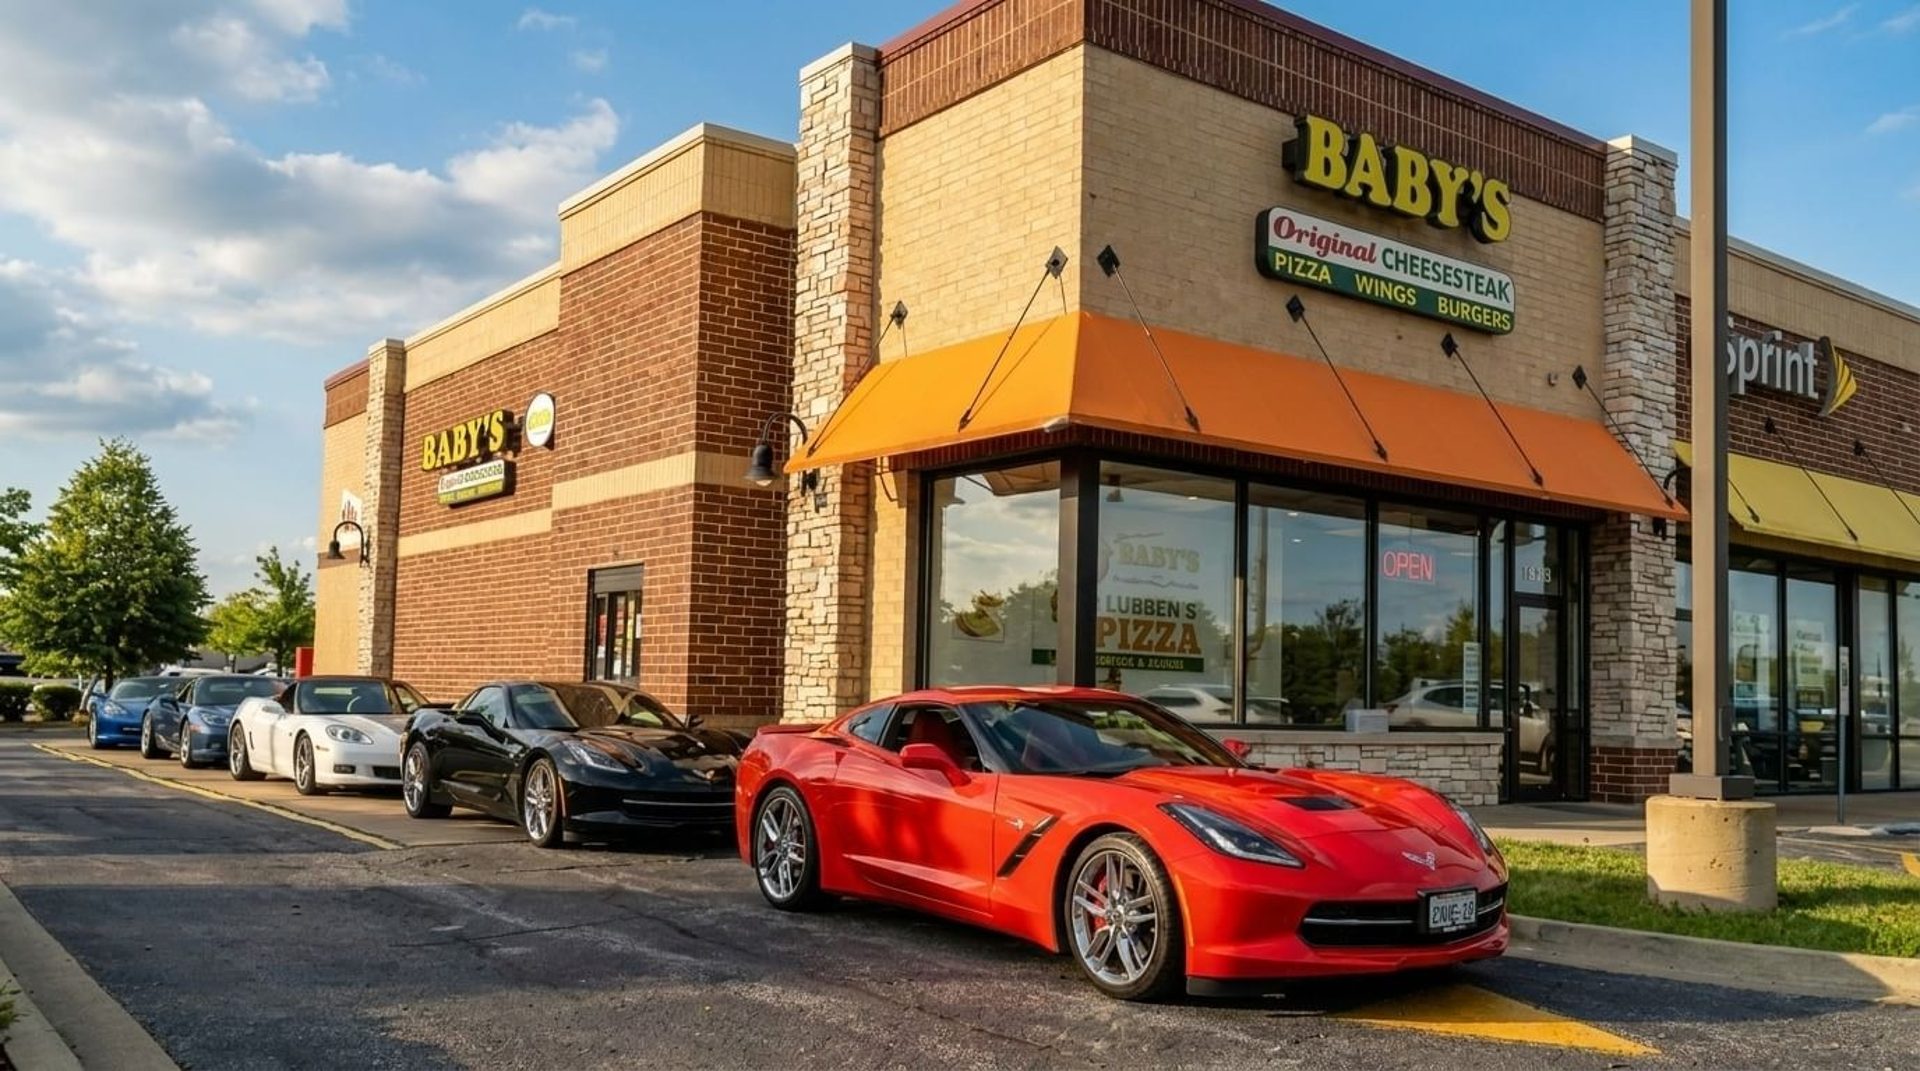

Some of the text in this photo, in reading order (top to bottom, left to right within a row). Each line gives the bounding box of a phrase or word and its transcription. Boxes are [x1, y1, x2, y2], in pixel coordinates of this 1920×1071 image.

[1303, 114, 1512, 242] BABY'S
[1273, 216, 1511, 303] Original CHEESESTEAK
[1274, 252, 1511, 331] PIZZA WINGS BURGERS
[422, 409, 505, 471] BABY'S
[1383, 550, 1434, 581] OPEN
[1097, 617, 1202, 655] PIZZA
